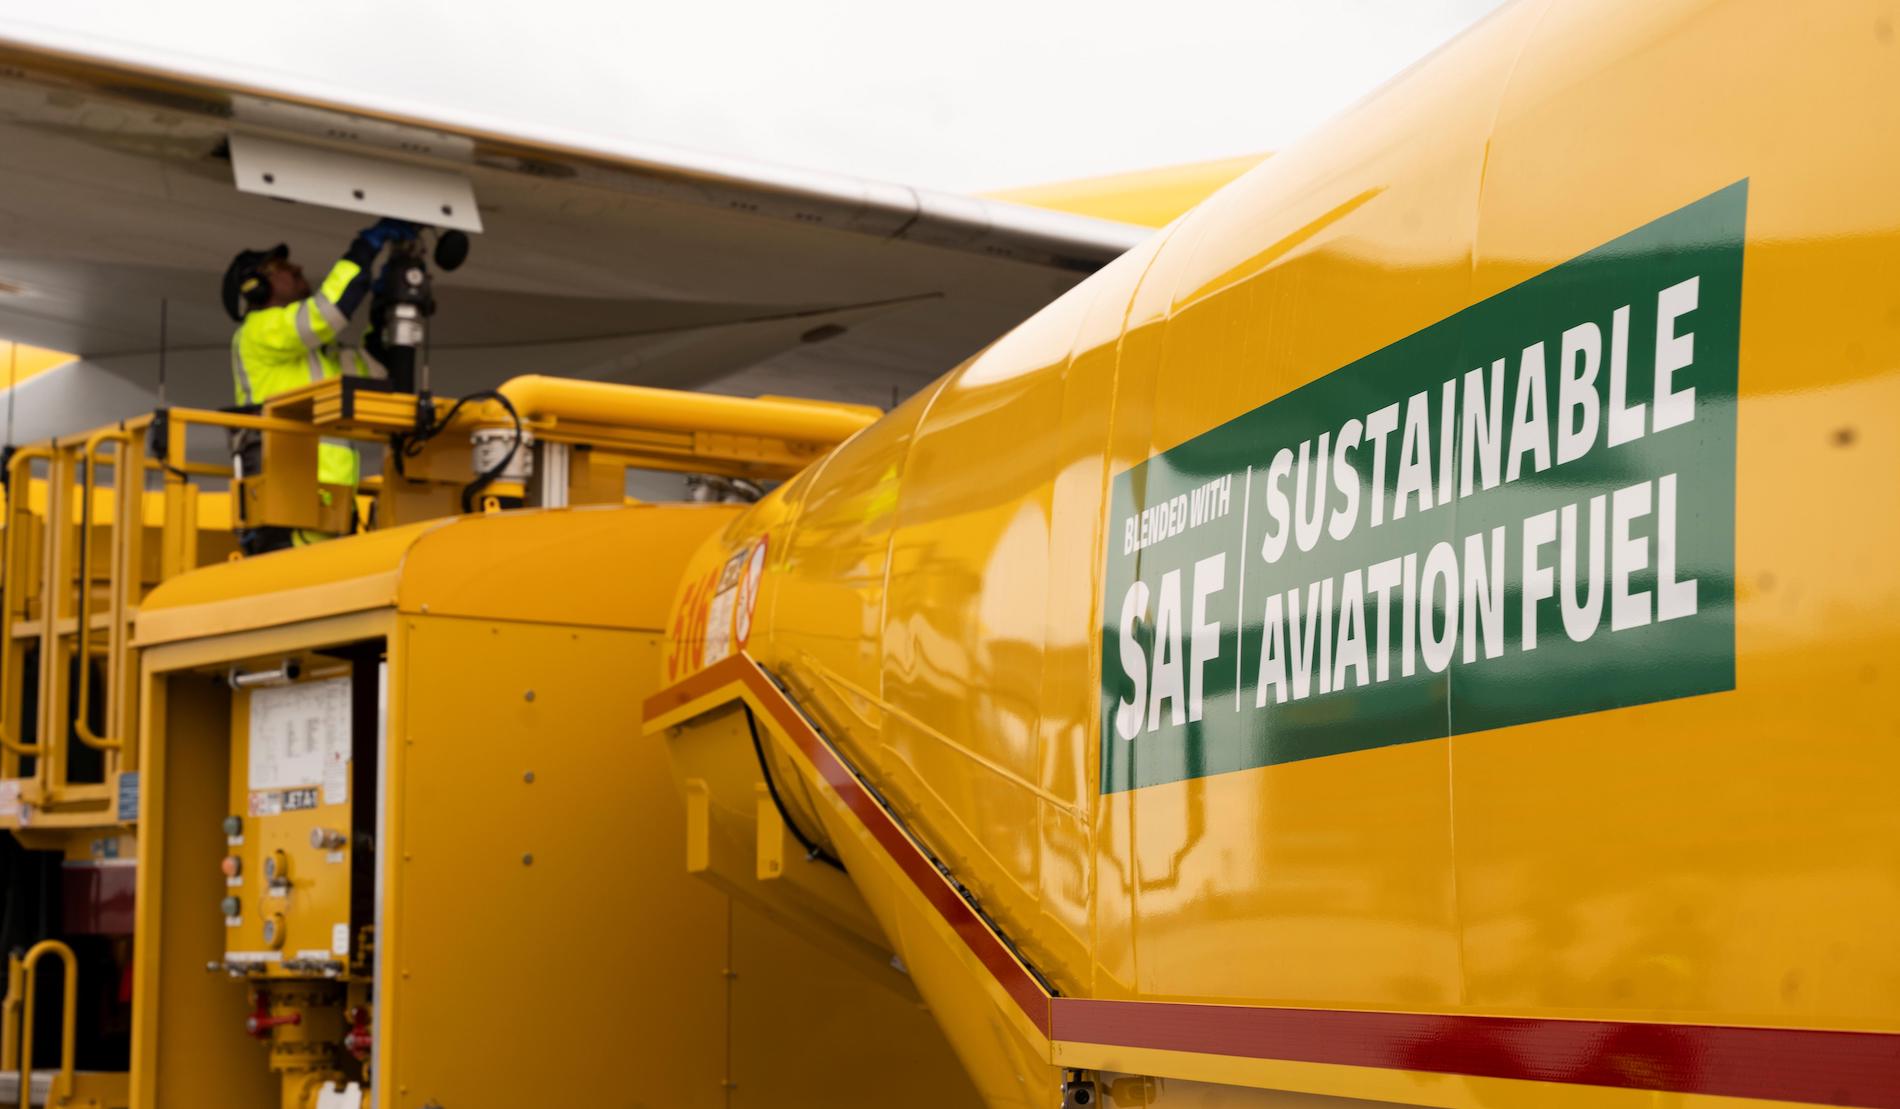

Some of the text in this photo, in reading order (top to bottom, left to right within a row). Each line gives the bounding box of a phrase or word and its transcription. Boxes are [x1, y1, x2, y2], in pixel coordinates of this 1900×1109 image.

[1123, 472, 1232, 556] BLENDED WITH
[1261, 275, 1701, 564] SUSTAINABLE
[1115, 551, 1227, 741] SAF
[1256, 472, 1700, 709] AVIATION FUEL
